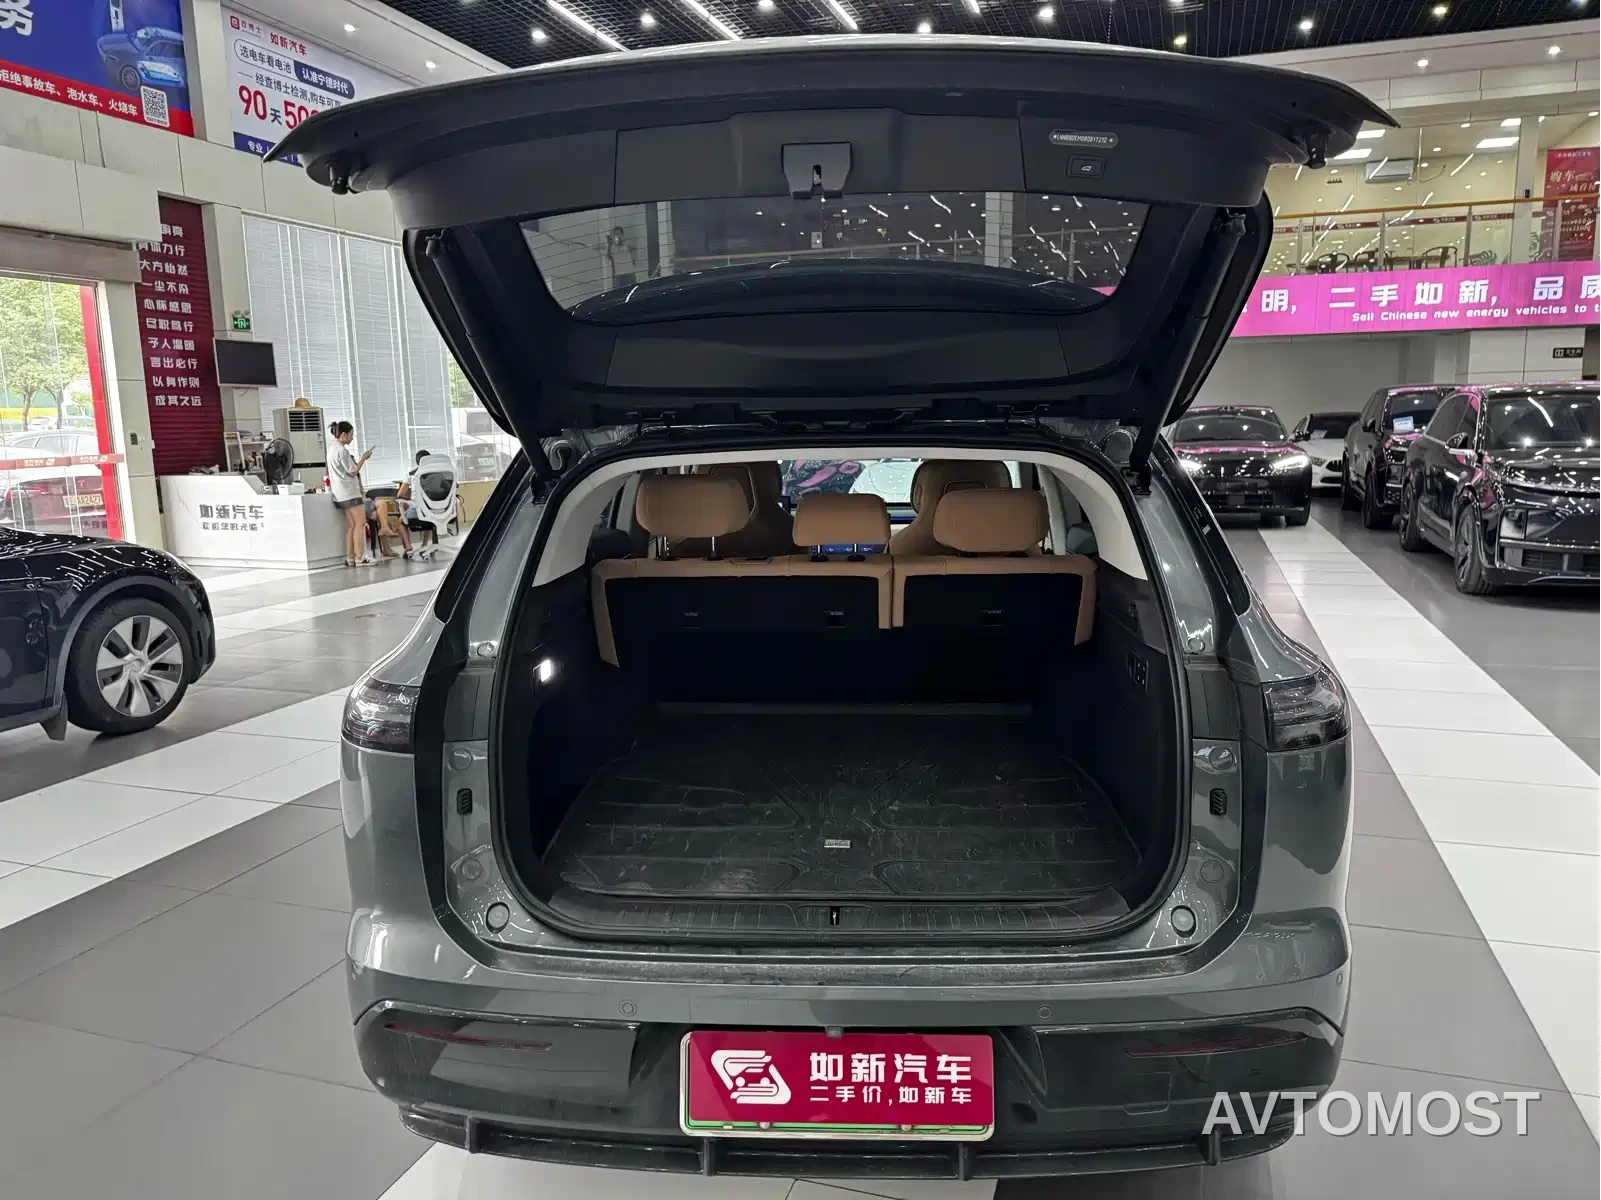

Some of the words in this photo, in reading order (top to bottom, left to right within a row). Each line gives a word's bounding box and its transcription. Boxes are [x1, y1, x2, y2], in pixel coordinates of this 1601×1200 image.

[269, 32, 307, 56] 如新汽车
[240, 44, 292, 74] 选电车看电池
[302, 67, 349, 94] 认准宁德时代
[140, 260, 188, 276] 大方怡然
[142, 281, 189, 294] 一尘不染
[144, 298, 192, 313] 心怀感恩
[1381, 311, 1427, 321] Chinese
[1434, 309, 1460, 319] new
[1466, 307, 1509, 318] energy
[1516, 304, 1567, 316] vehicles
[1574, 303, 1587, 313] to
[148, 337, 195, 351] 予人温暖
[150, 357, 198, 369] 言出必行
[153, 376, 200, 388] 以身作则
[155, 395, 202, 407] 成其久远
[199, 504, 264, 519] 如新汽车
[810, 1052, 972, 1083] 如新汽车
[810, 1086, 972, 1106] 二手价,如新车
